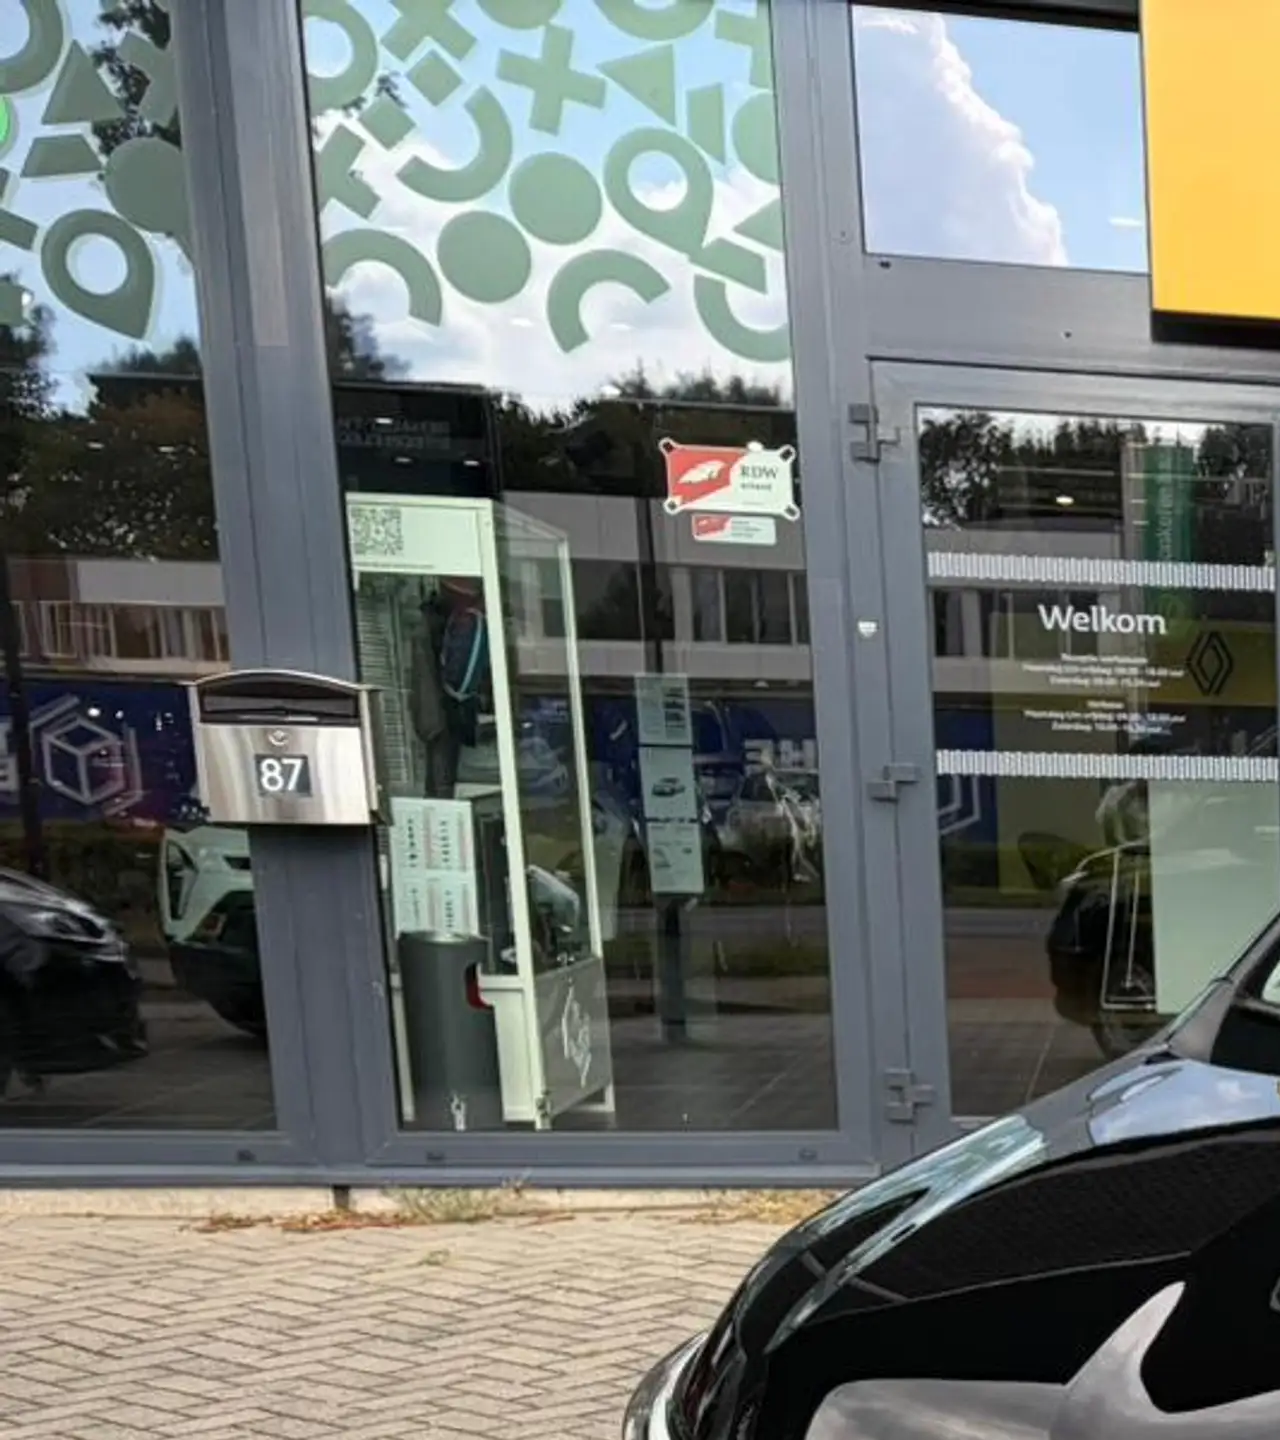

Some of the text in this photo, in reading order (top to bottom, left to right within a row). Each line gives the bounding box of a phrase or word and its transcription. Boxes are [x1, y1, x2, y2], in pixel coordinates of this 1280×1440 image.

[740, 464, 778, 479] RDW
[1037, 603, 1167, 636] Welkom
[259, 758, 304, 792] 87
